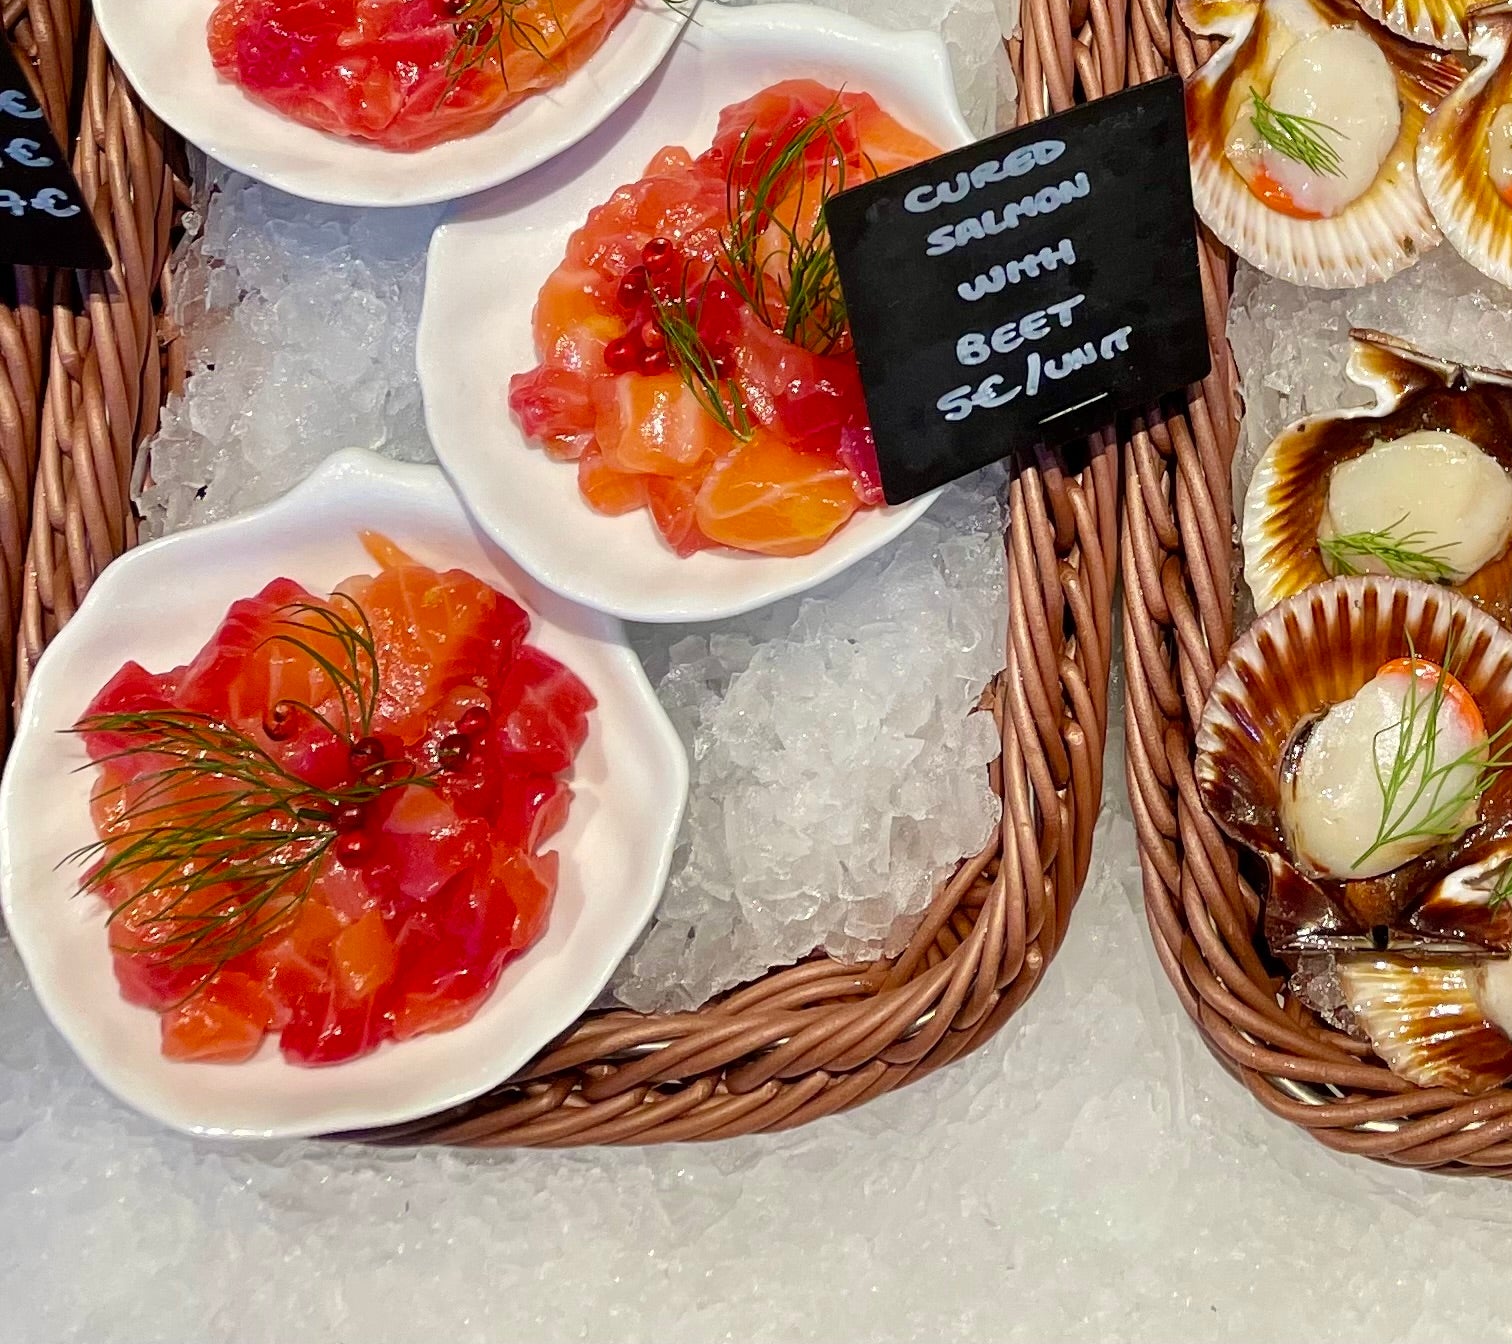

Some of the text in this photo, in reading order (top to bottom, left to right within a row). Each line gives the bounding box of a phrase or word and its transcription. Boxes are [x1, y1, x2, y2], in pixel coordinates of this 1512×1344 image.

[904, 139, 1067, 213] CURED
[926, 172, 1091, 256] SALMON
[956, 294, 1085, 365] BEET
